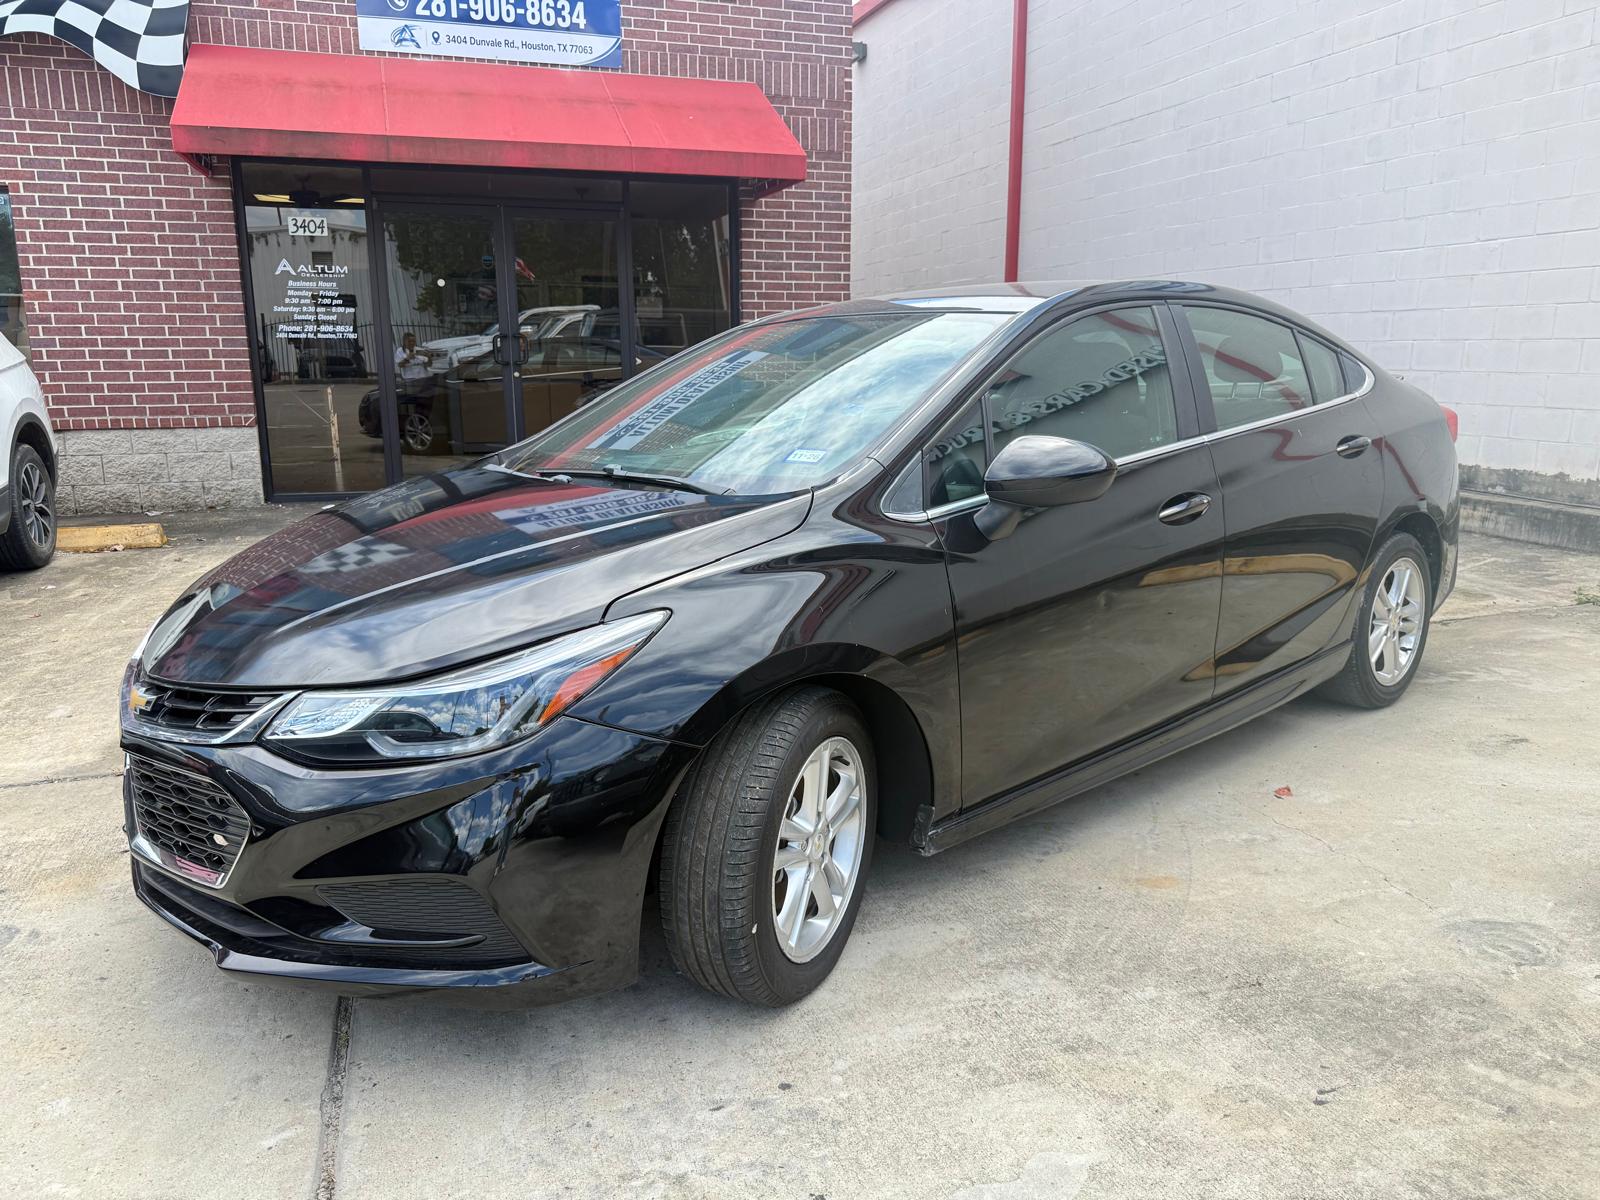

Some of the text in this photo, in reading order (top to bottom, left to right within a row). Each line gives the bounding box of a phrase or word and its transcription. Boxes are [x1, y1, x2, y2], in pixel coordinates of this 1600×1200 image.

[415, 0, 587, 30] 281-906-8634
[445, 34, 593, 55] 3404 Dunvale Rd., Houston, TX 77063
[290, 218, 326, 235] 3404
[297, 264, 348, 274] ALTUM
[319, 290, 339, 298] Friday
[273, 305, 302, 313] Saturday:
[293, 313, 317, 321] Sunday:
[278, 324, 354, 332] Phone: 281-906-8634
